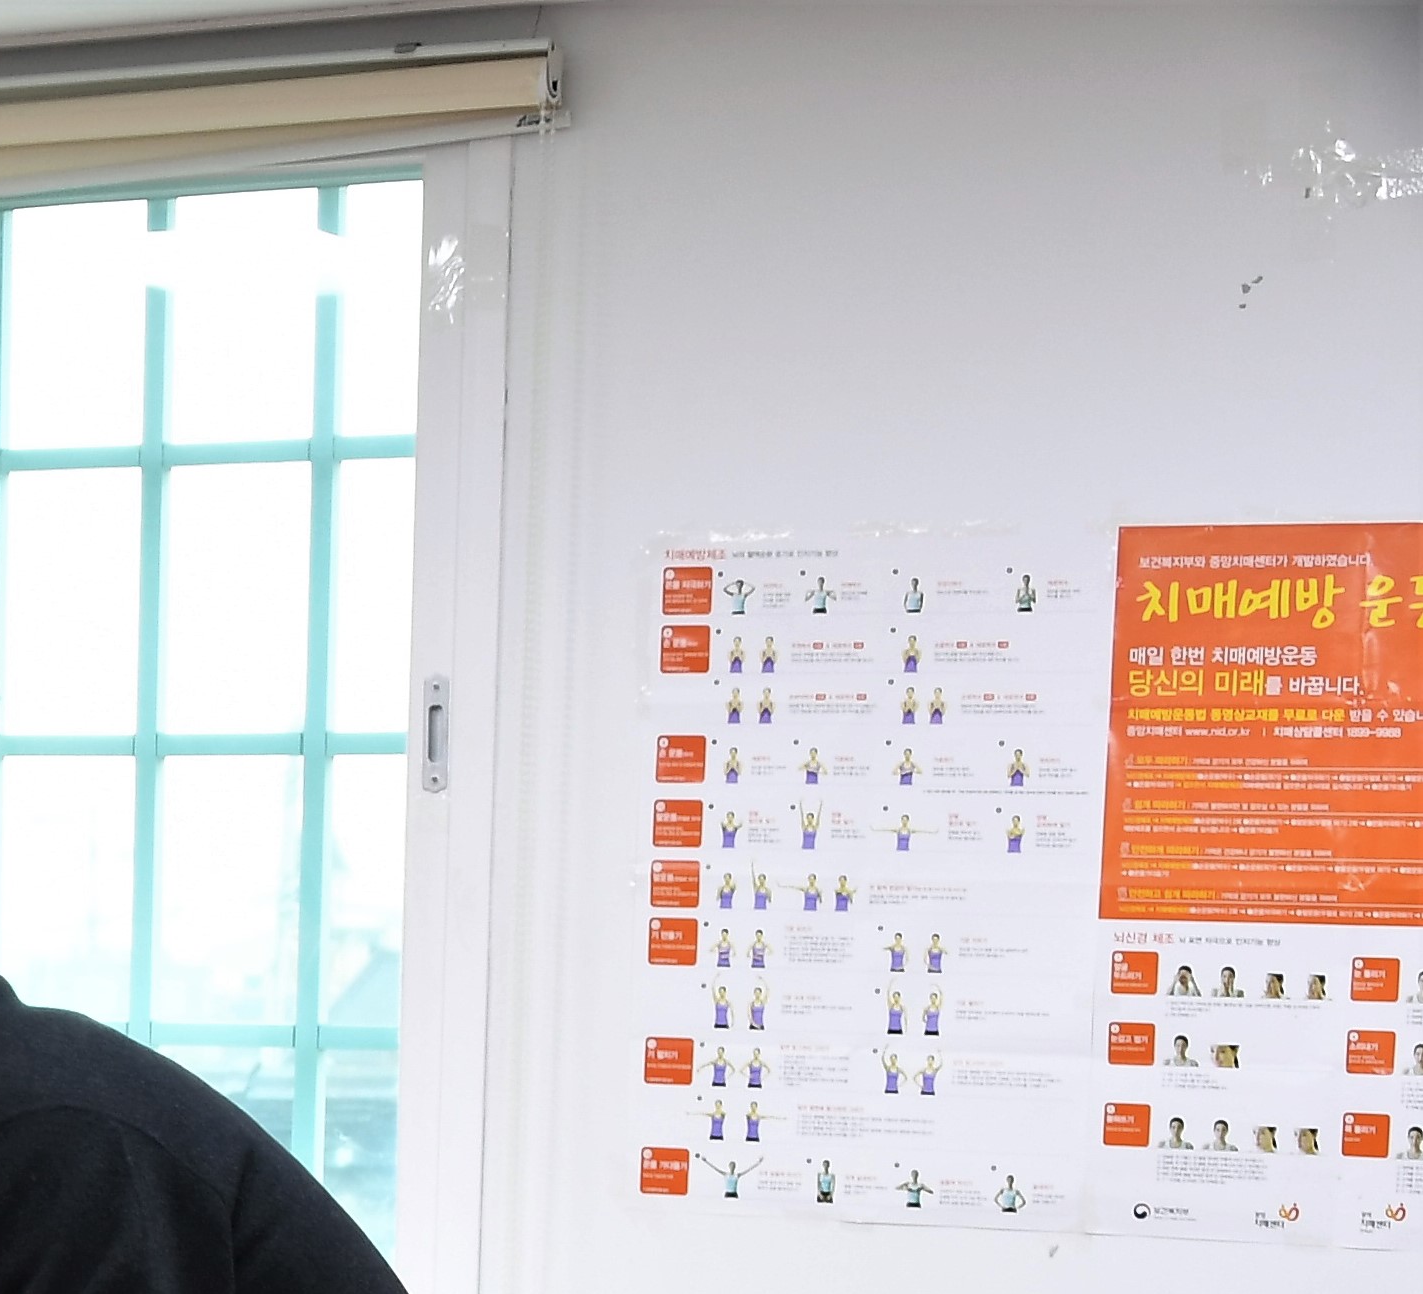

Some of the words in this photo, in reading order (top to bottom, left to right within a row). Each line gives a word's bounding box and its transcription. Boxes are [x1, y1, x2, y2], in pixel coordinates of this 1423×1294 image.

[1138, 556, 1206, 569] 보건복지부와
[1209, 555, 1289, 569] 중앙치매센터가
[1292, 554, 1374, 568] 개발하였습니다.
[1136, 573, 1346, 630] 치매예방
[1129, 646, 1164, 667] 매일
[1170, 646, 1205, 666] 한번
[1211, 645, 1318, 667] 치매예방운동
[1128, 669, 1205, 697] 당신의
[1215, 668, 1283, 697] 미래를
[1289, 675, 1365, 696] 바꿉니다.
[1127, 708, 1207, 722] 치매예방운동법
[1210, 708, 1279, 722] 동영상교재를
[1283, 708, 1318, 722] 무료로
[1321, 708, 1345, 722] 다운
[1349, 708, 1372, 723] 받을
[1376, 709, 1388, 722] 수
[1126, 725, 1183, 737] 중앙치매센터
[1113, 931, 1148, 945] 뇌신경
